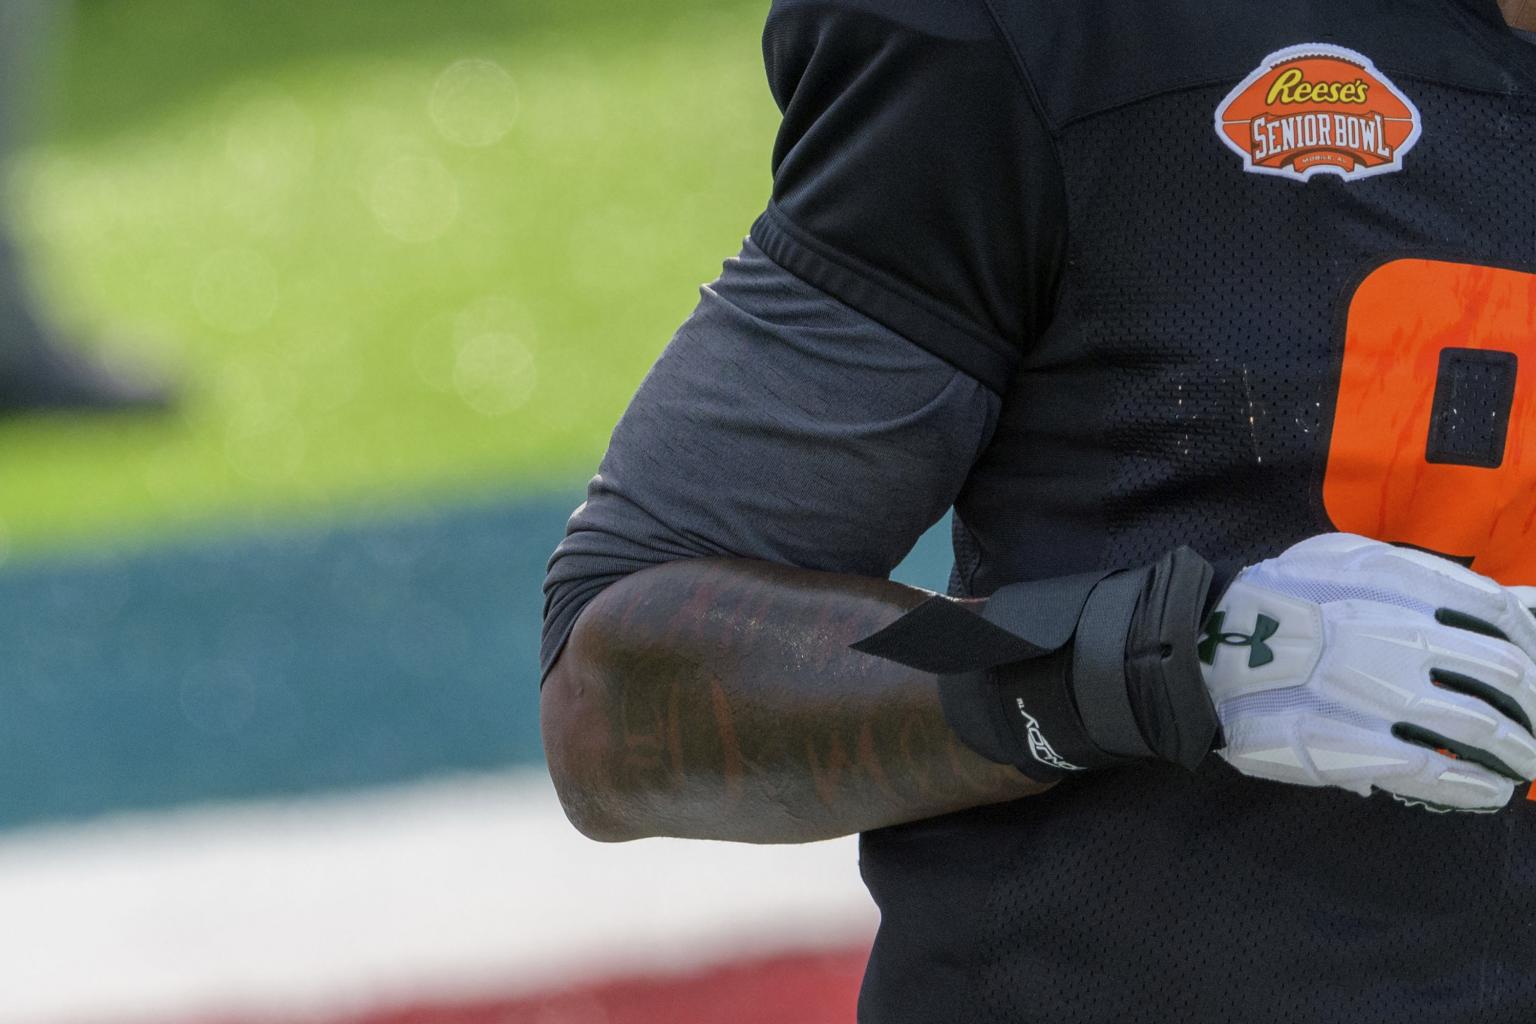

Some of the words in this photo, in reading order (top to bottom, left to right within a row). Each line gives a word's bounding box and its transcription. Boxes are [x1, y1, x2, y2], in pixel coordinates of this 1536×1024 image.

[1266, 68, 1369, 106] Reese's
[1253, 114, 1331, 160] SENIOR
[1334, 114, 1390, 159] BOWL
